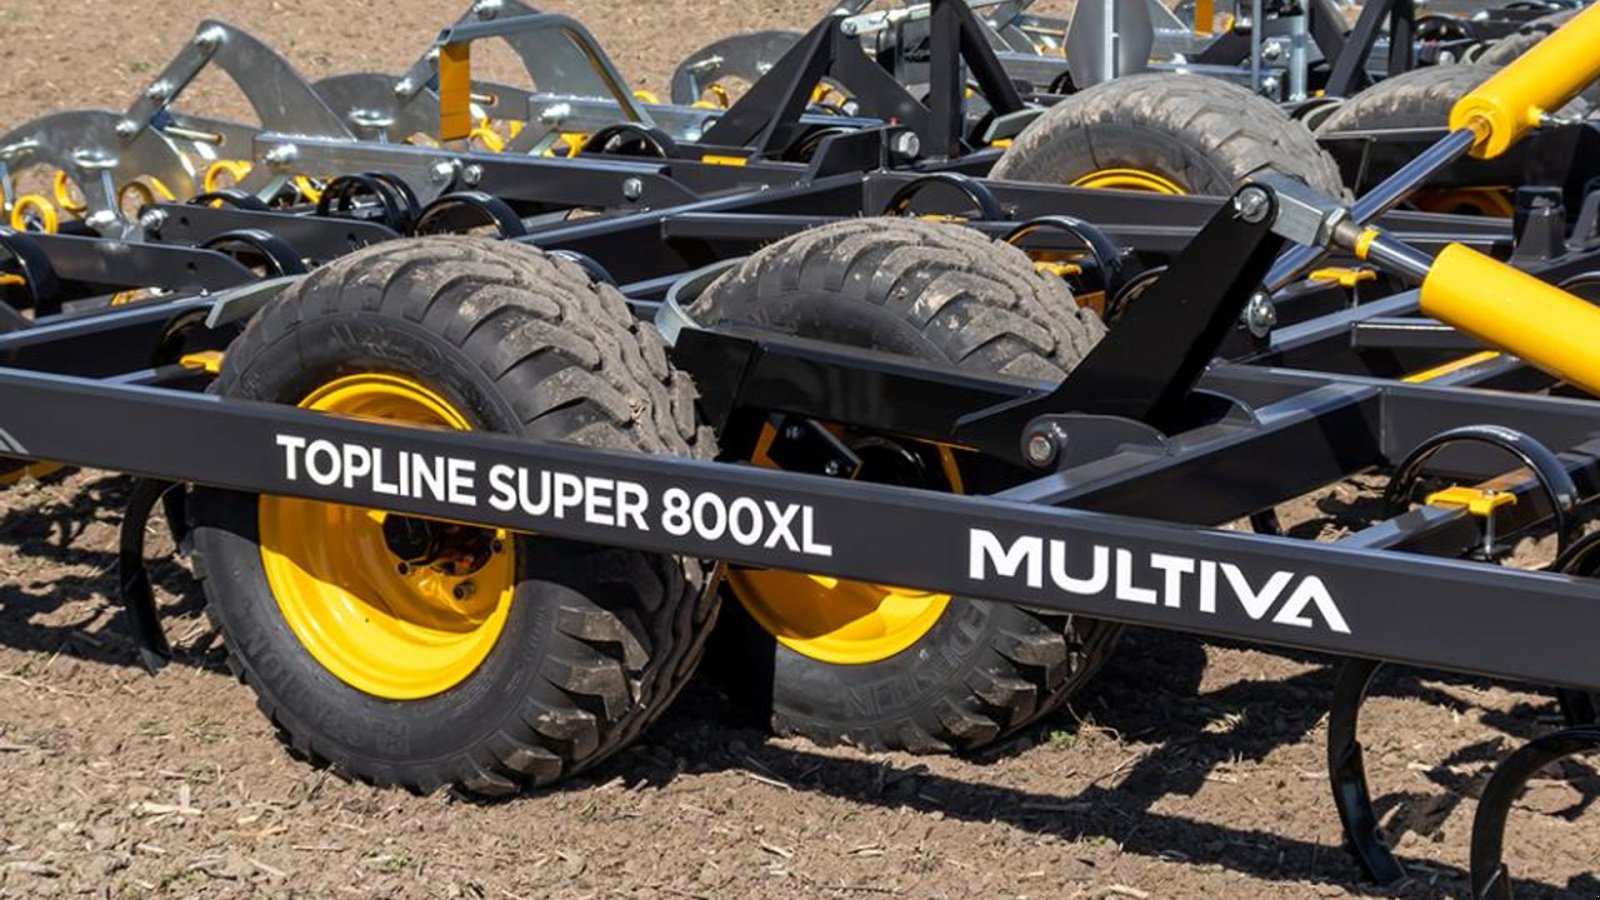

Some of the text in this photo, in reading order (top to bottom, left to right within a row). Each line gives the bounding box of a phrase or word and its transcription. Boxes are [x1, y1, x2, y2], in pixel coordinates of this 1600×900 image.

[276, 434, 833, 556] TOPLINE SUPER 800XL
[969, 528, 1351, 634] MULTIVA
